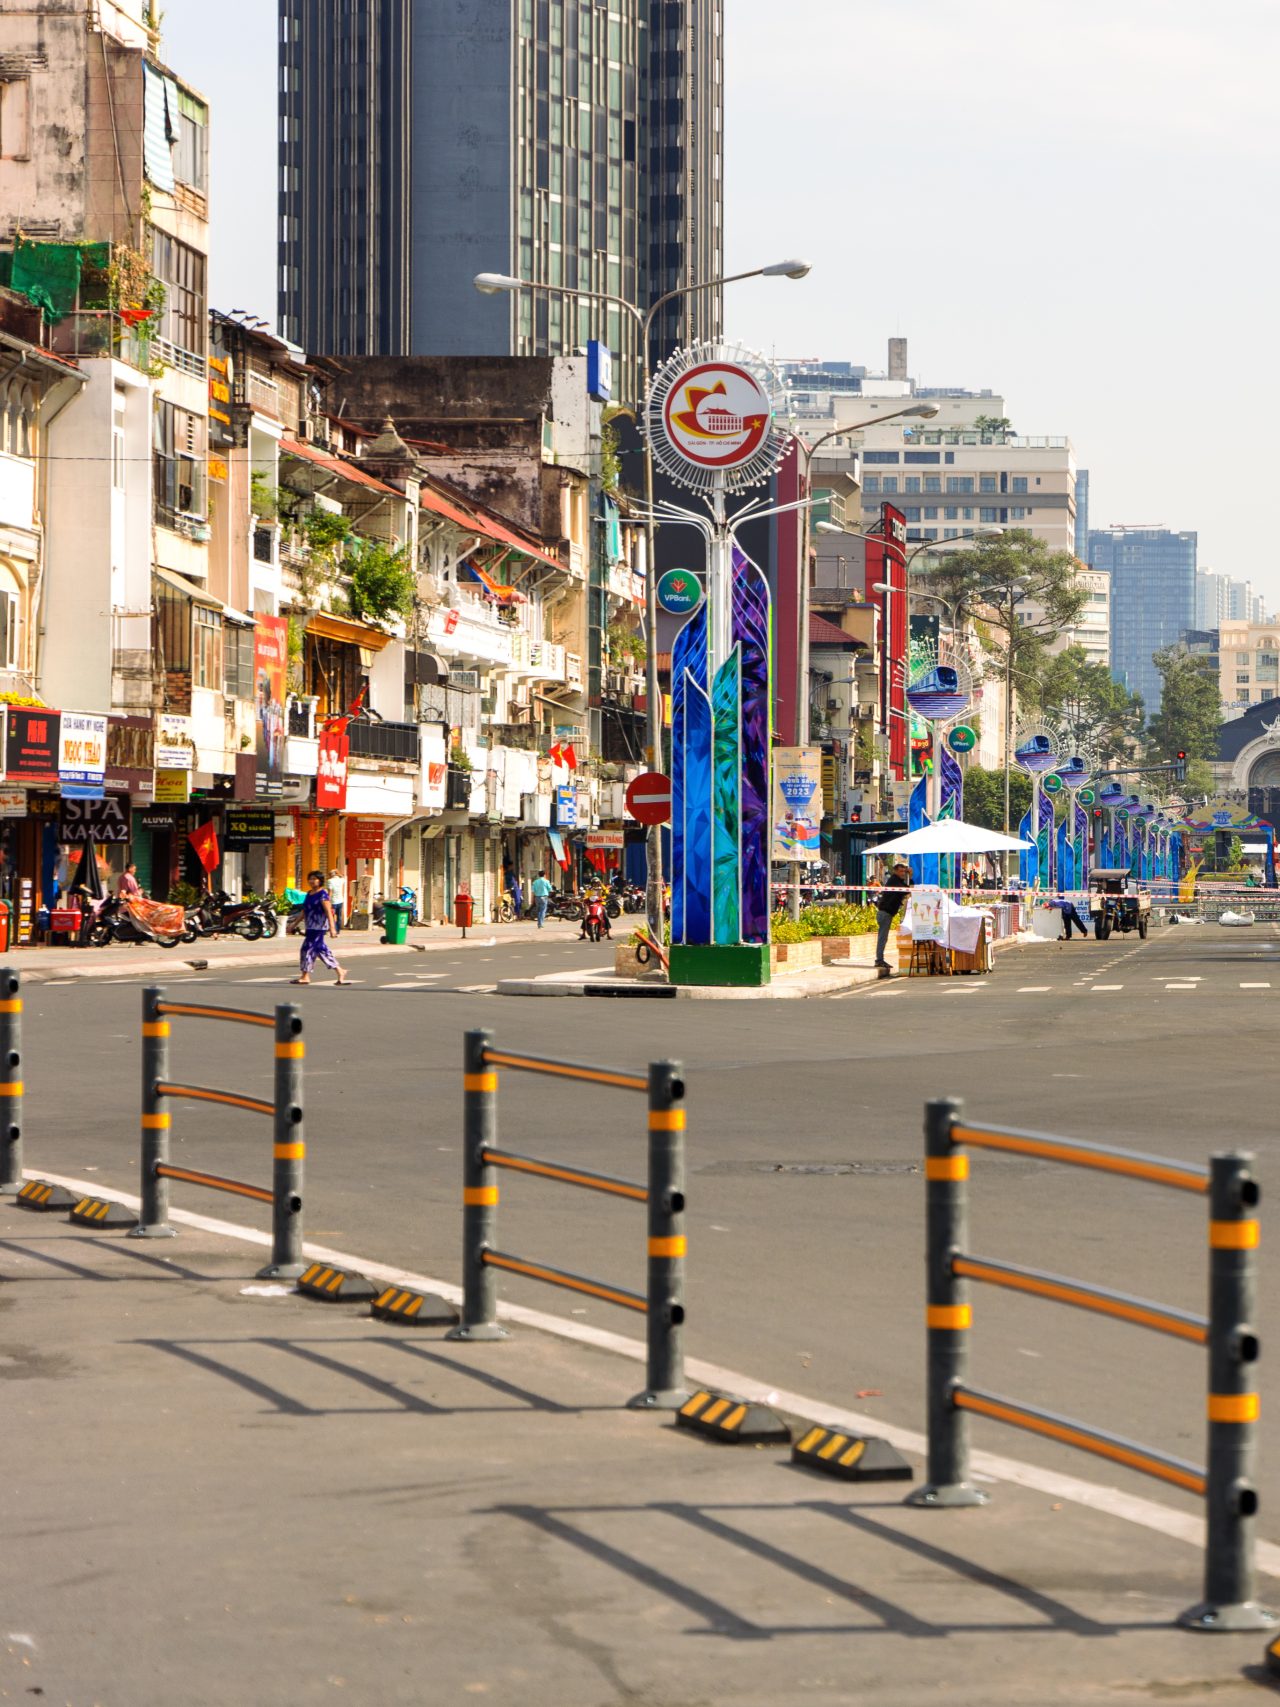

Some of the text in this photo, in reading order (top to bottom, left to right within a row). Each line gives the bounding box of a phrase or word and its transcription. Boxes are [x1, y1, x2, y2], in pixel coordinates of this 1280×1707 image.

[787, 787, 810, 796] 2023
[65, 799, 124, 820] SPA
[142, 816, 174, 825] ALUVIA
[62, 823, 129, 840] KAKA2
[231, 821, 248, 833] XQ
